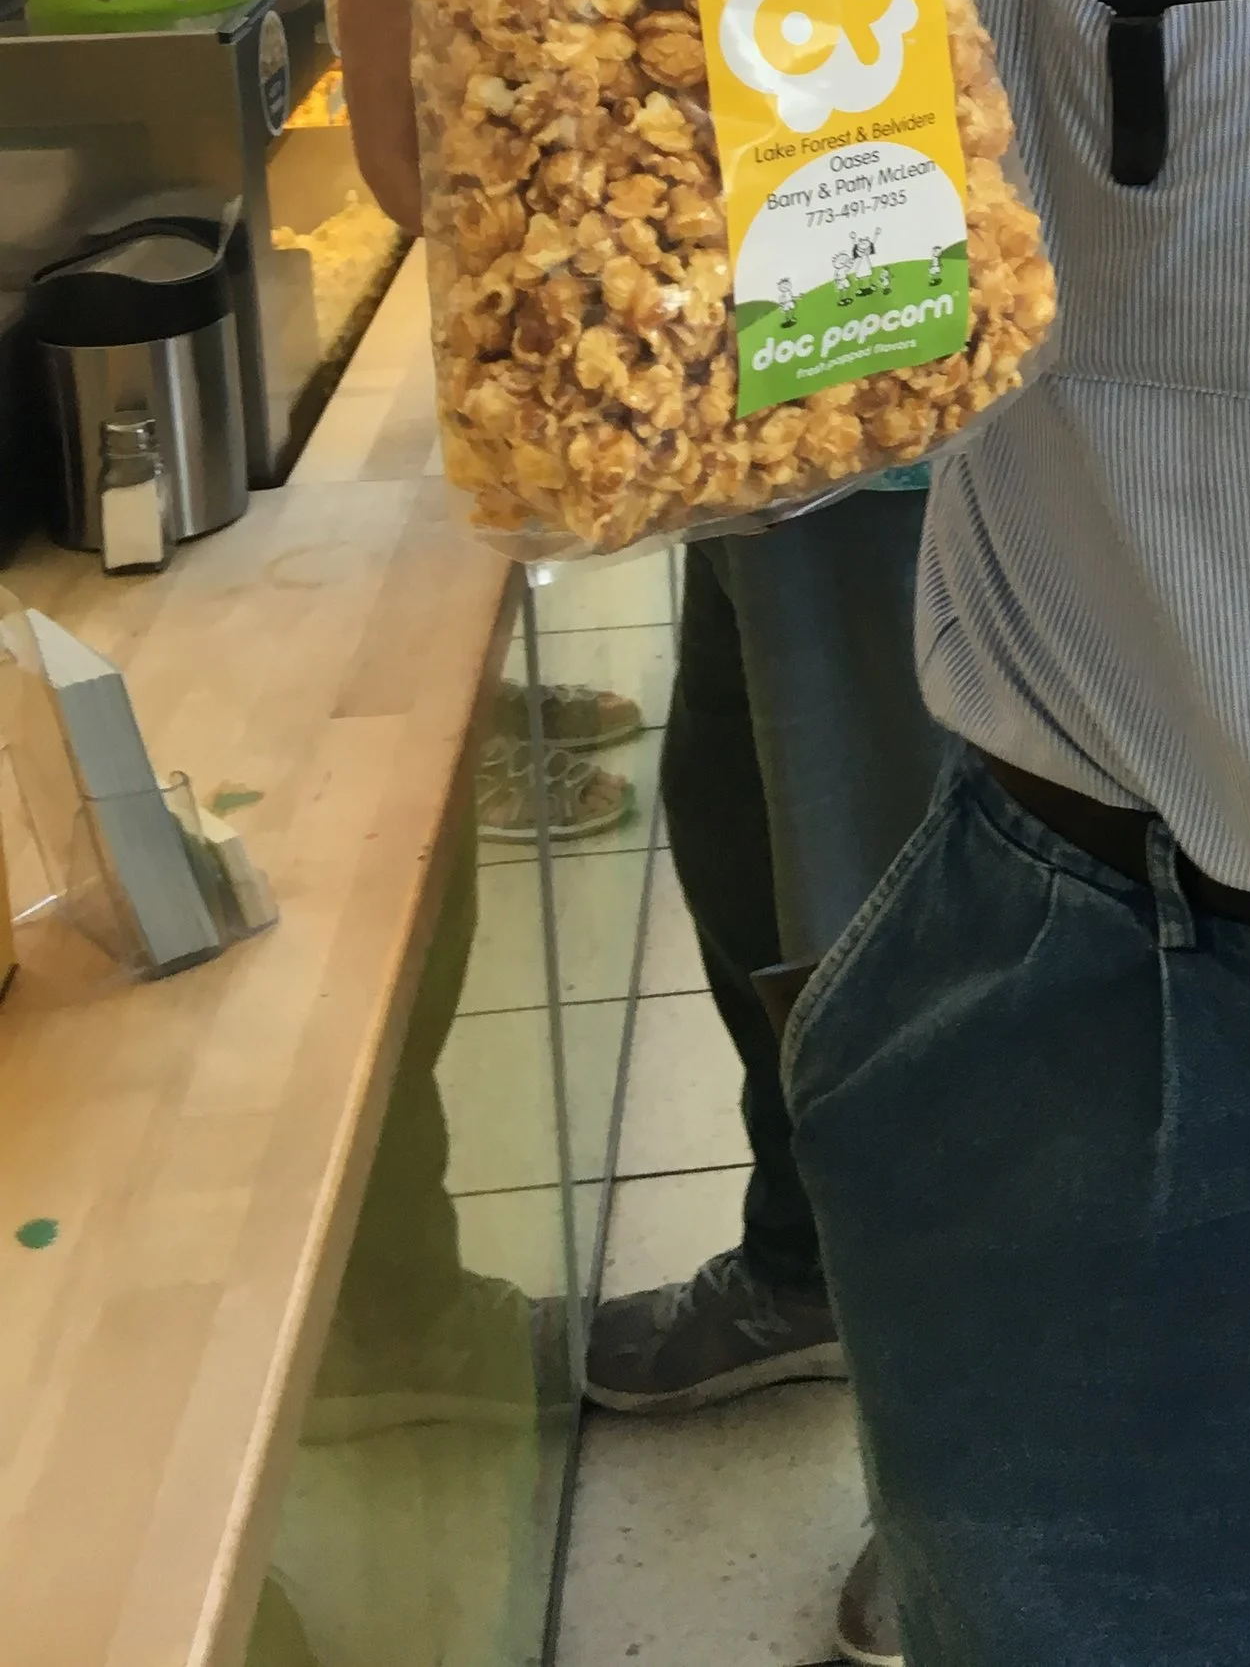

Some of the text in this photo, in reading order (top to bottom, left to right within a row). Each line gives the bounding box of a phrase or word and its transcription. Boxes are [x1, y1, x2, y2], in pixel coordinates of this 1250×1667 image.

[754, 111, 936, 163] Lake Forest & Belvidere
[829, 149, 880, 172] Oases
[767, 159, 937, 210] Barry & Patty McLean
[805, 189, 908, 228] 773-491-7935
[752, 337, 815, 371] doc
[820, 293, 955, 359] popcorn
